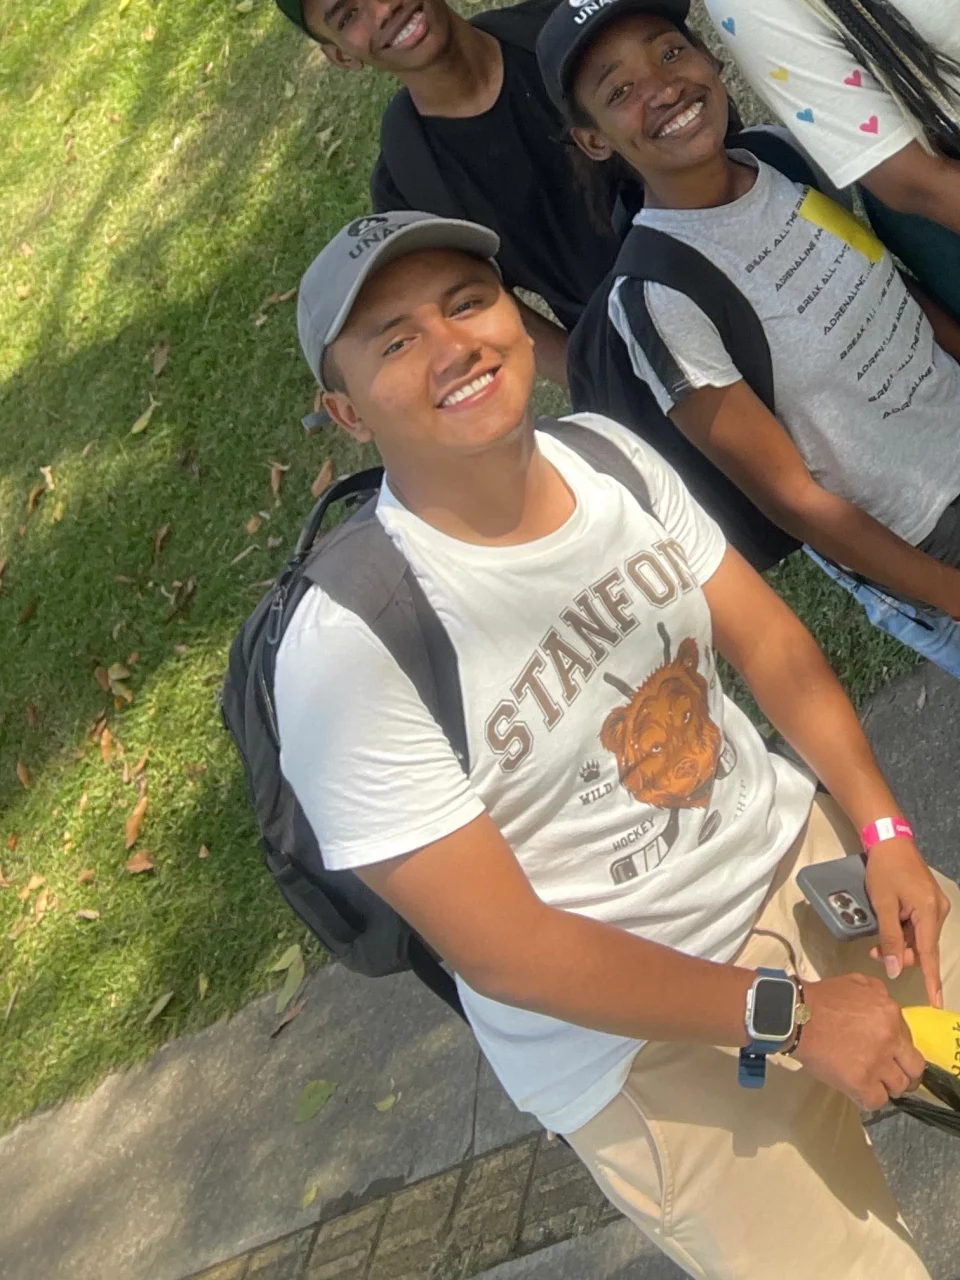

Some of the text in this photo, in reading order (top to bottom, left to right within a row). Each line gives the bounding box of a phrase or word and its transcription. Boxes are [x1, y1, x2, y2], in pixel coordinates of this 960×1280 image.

[774, 229, 790, 247] ALL
[786, 210, 798, 227] THE
[775, 239, 816, 293] ADRENALINE
[797, 284, 823, 314] BREAK
[821, 268, 837, 285] ALL
[840, 325, 866, 360] BREAK
[579, 783, 613, 806] WILD
[612, 817, 655, 851] HOCKEY
